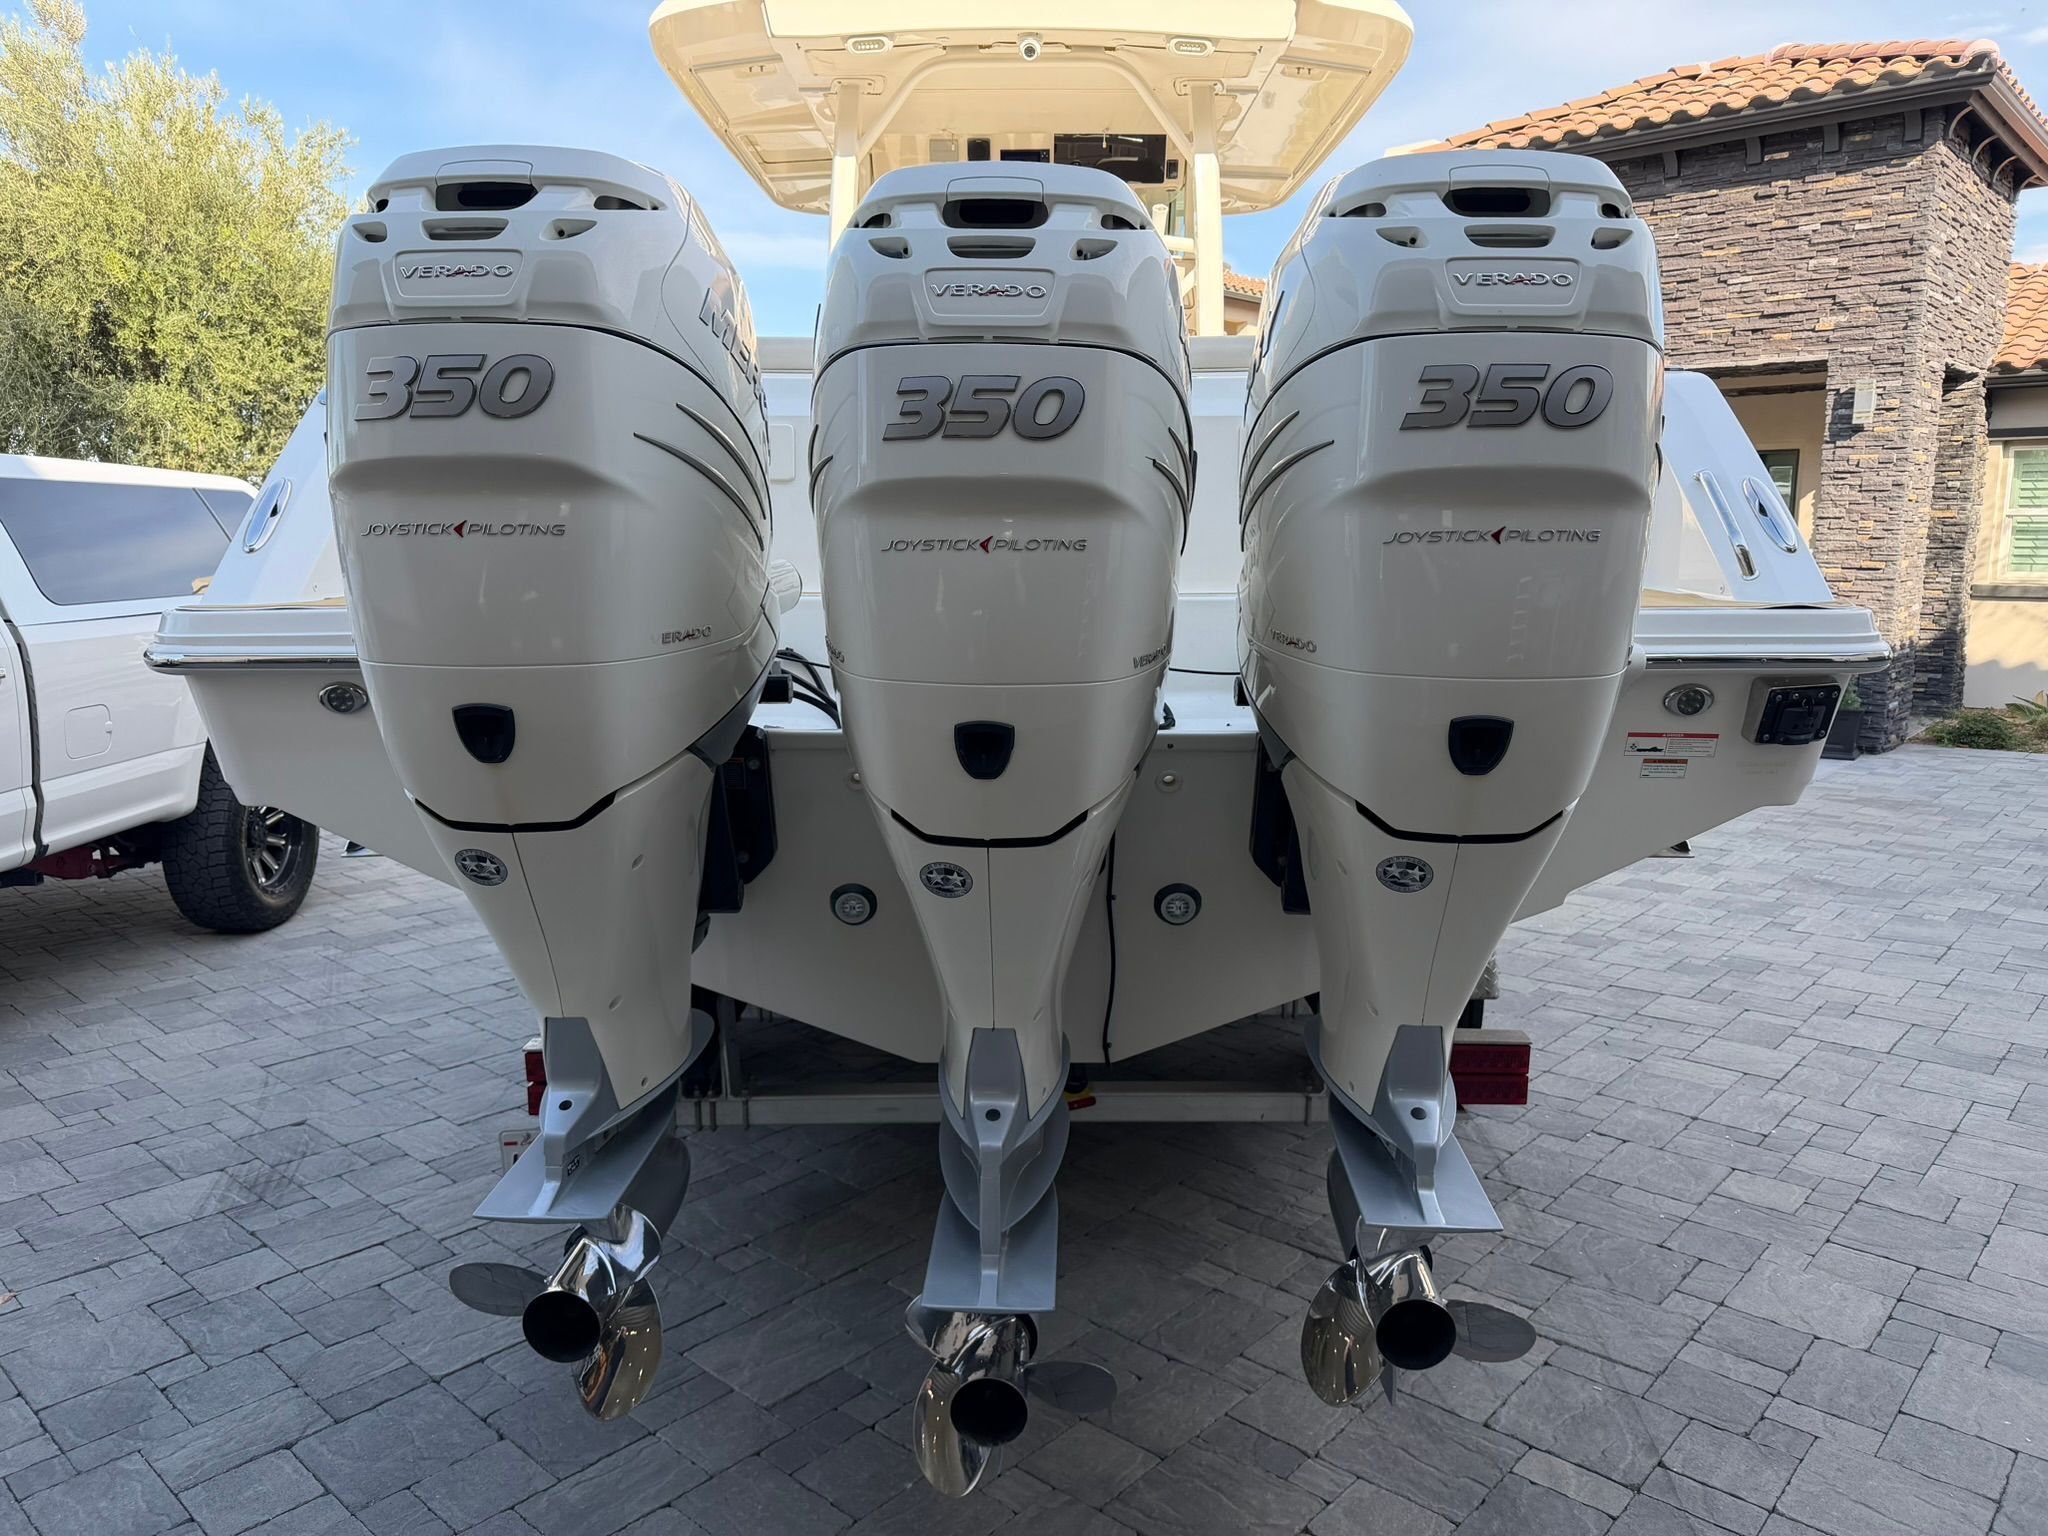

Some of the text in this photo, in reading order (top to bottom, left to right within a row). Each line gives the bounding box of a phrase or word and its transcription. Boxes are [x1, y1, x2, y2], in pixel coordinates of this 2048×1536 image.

[400, 264, 514, 279] VERADO
[1453, 272, 1573, 287] VERADO
[930, 282, 1047, 299] VERADO
[354, 353, 556, 421] 350
[1399, 363, 1614, 430] 350
[882, 374, 1086, 442] 350
[360, 522, 566, 537] JOYSTICK PILOTING
[1382, 529, 1602, 544] JOYSTICK PILOTING
[881, 538, 1088, 552] JOYSTICK PILOTING
